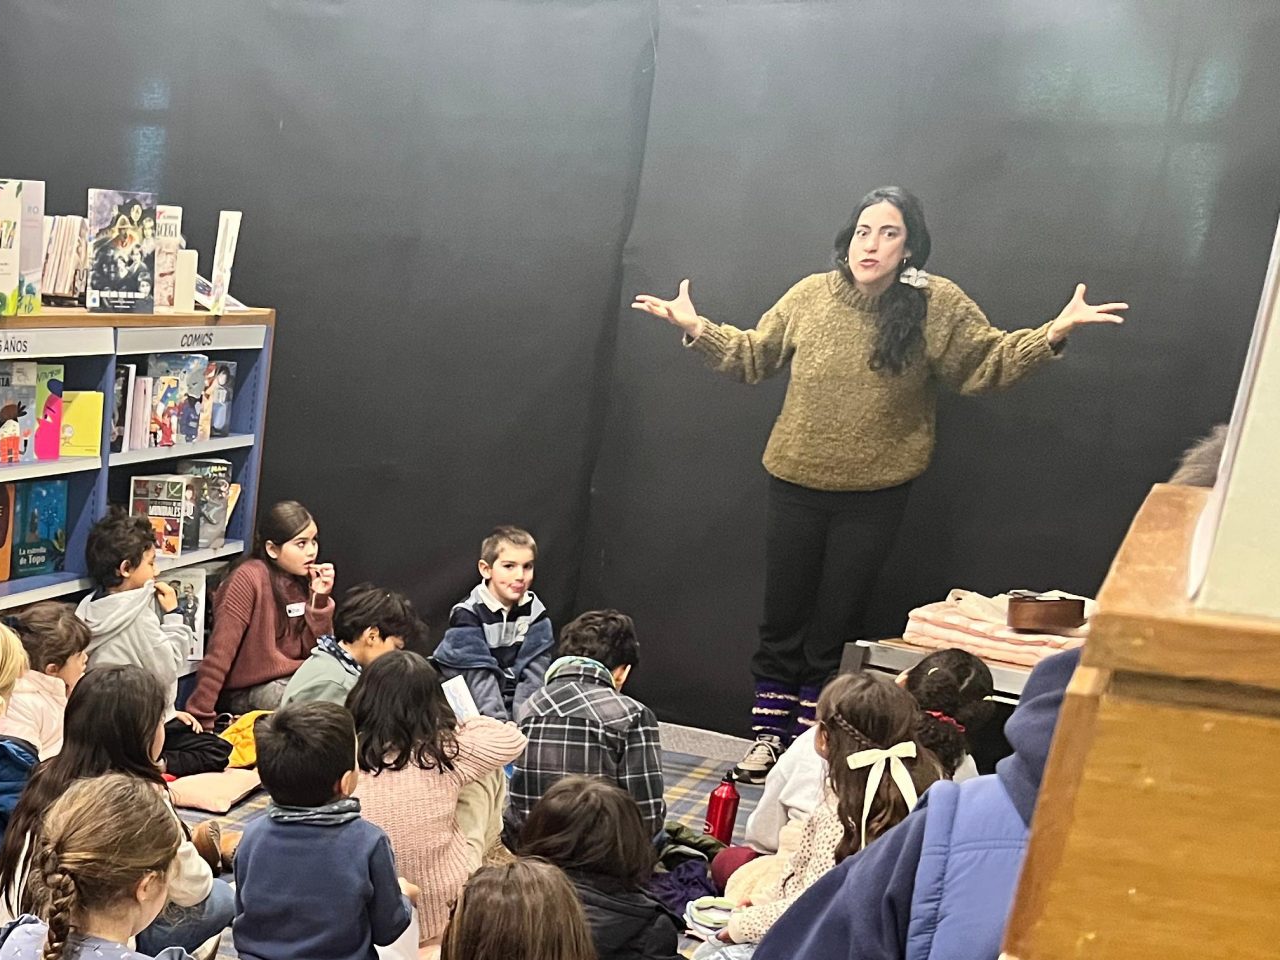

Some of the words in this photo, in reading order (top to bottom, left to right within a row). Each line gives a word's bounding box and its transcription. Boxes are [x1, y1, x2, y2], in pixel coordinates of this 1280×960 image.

[3, 337, 28, 353] AÑOS
[180, 332, 214, 347] COMICS
[18, 548, 26, 556] La
[19, 557, 27, 565] de
[28, 554, 46, 566] Topo
